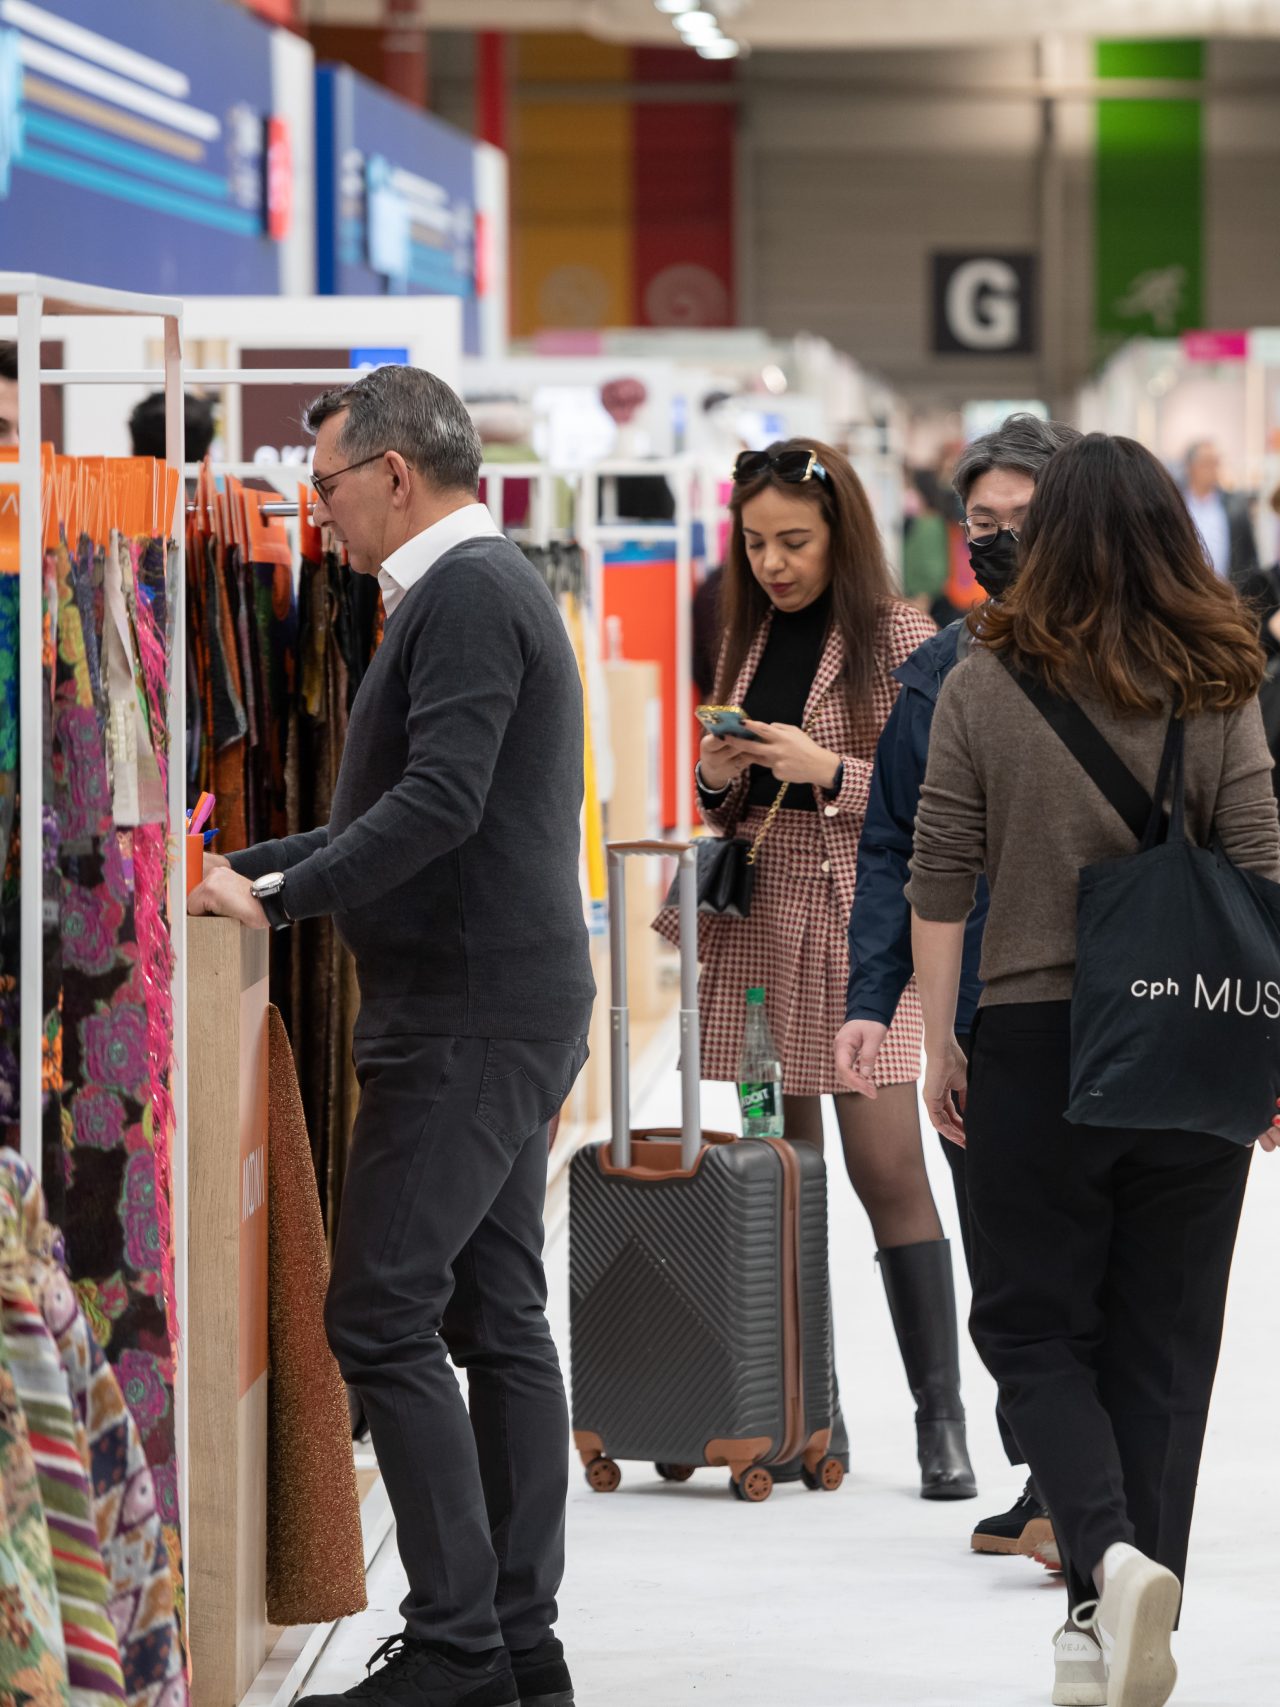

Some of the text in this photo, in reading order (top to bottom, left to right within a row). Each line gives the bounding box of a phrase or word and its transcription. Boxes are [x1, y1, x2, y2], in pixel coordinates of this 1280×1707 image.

[945, 258, 1020, 348] G
[1131, 977, 1180, 1000] cph
[1061, 1642, 1088, 1652] VEJA
